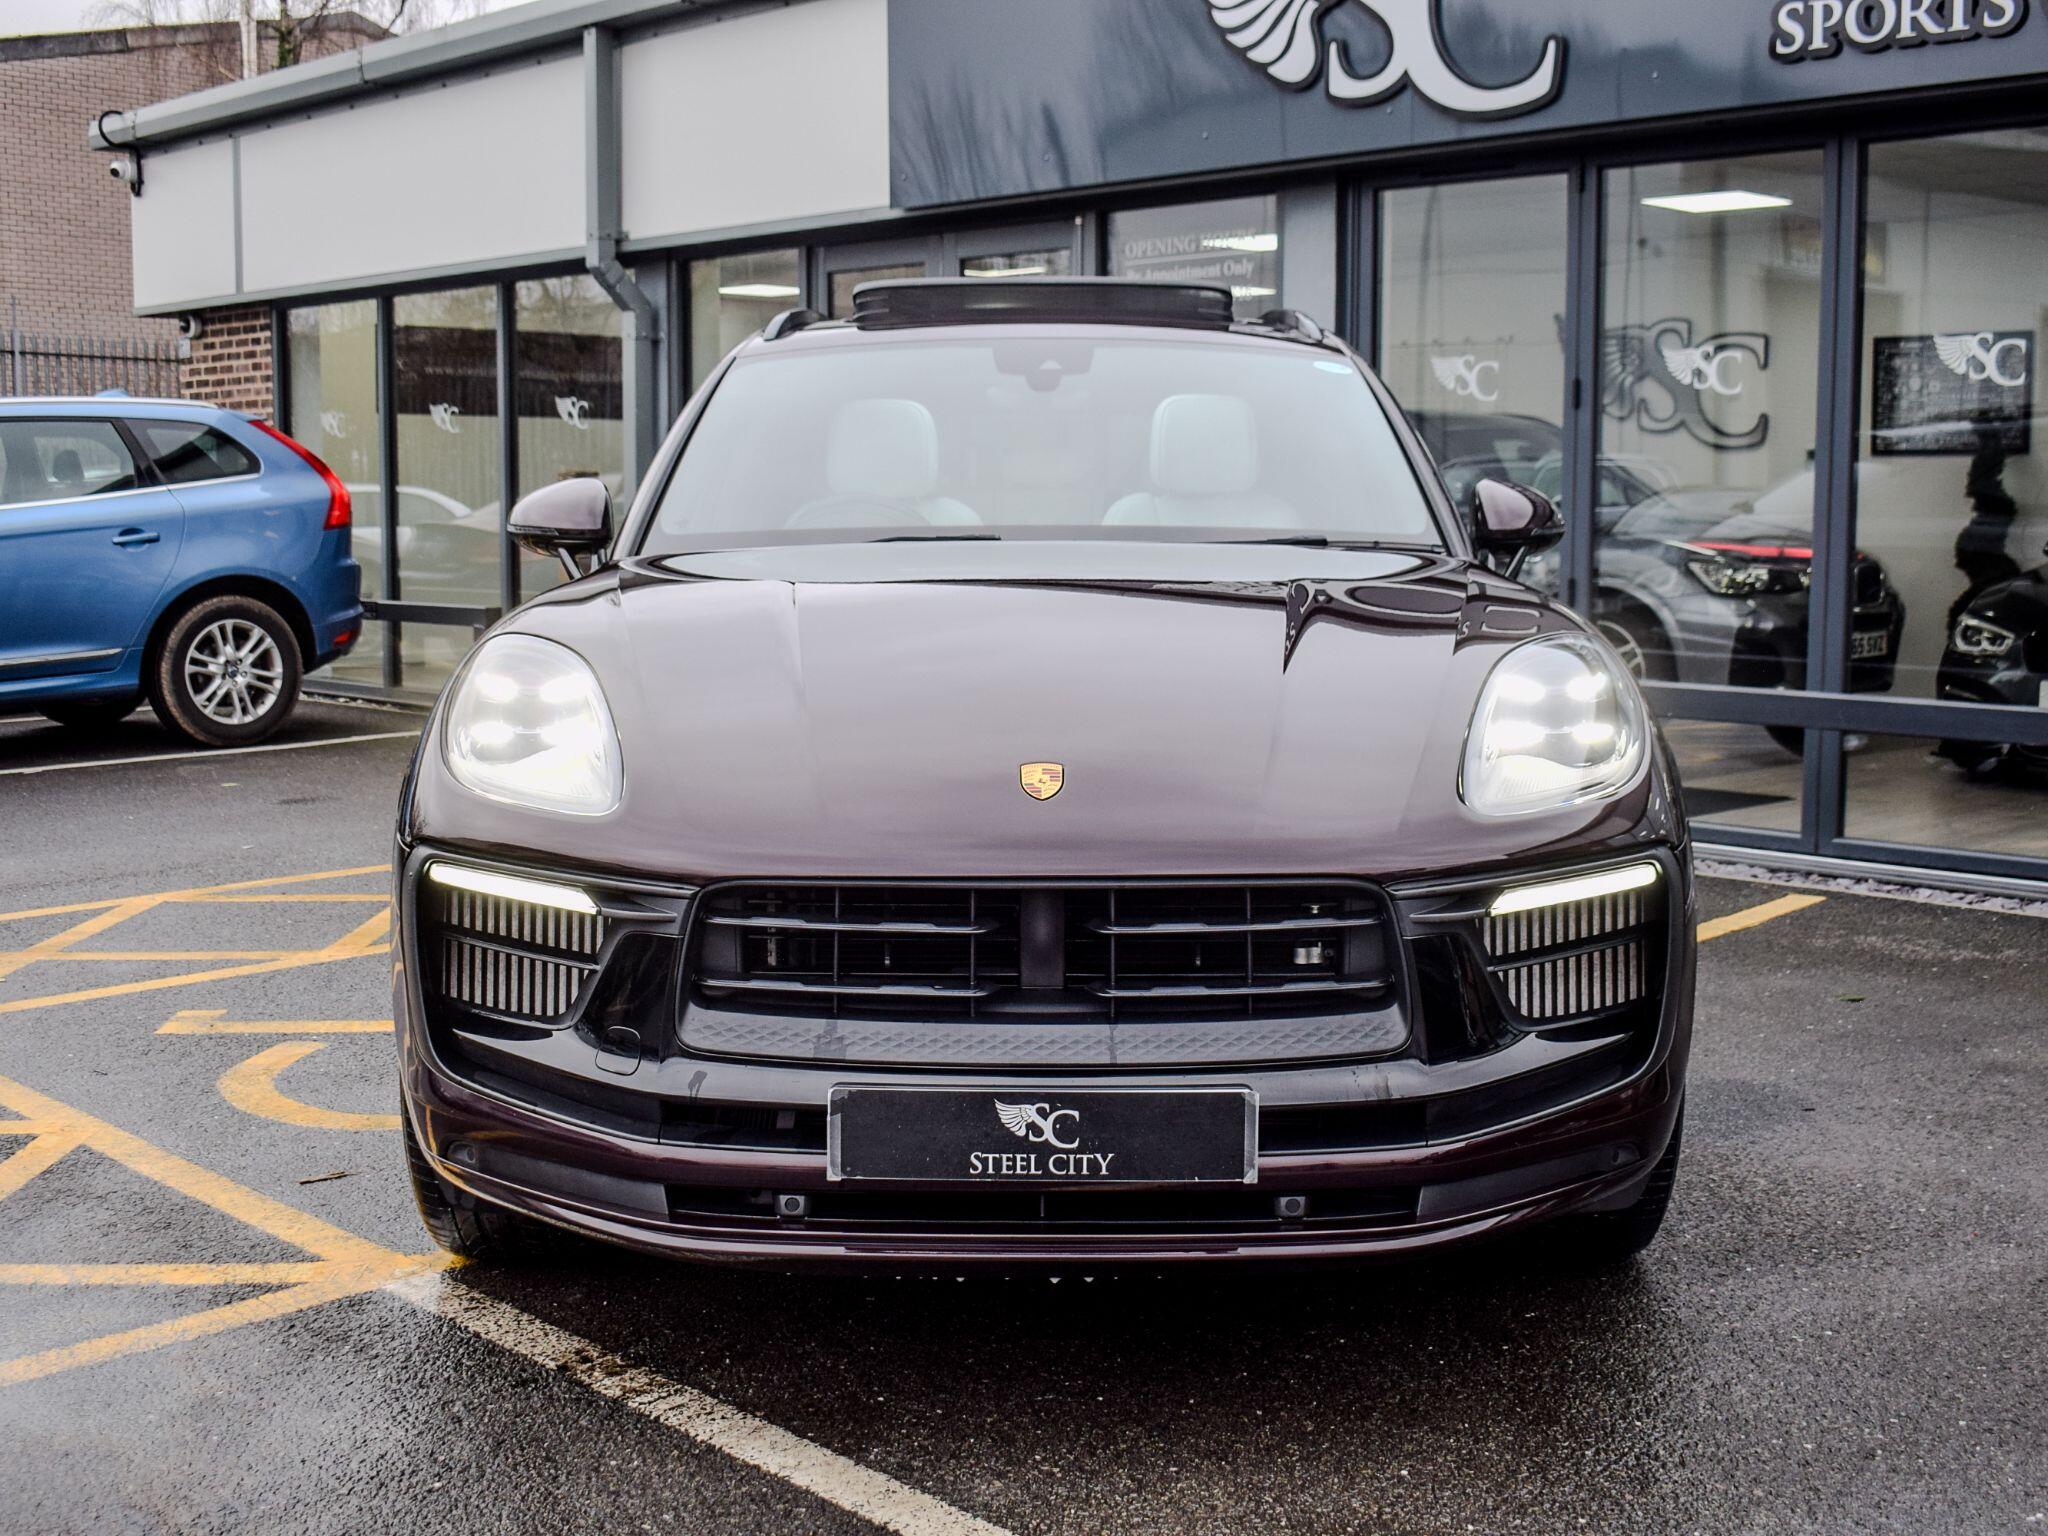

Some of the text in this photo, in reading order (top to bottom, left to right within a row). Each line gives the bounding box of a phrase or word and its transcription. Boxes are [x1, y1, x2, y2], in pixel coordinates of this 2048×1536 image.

[1124, 234, 1197, 258] OPENING
[1223, 258, 1256, 279] Only
[1456, 353, 1500, 402] SC
[1691, 346, 1743, 396] SC
[1970, 332, 2027, 386] SC
[1028, 1102, 1080, 1149] SC
[969, 1151, 1115, 1176] STEEL CITY
